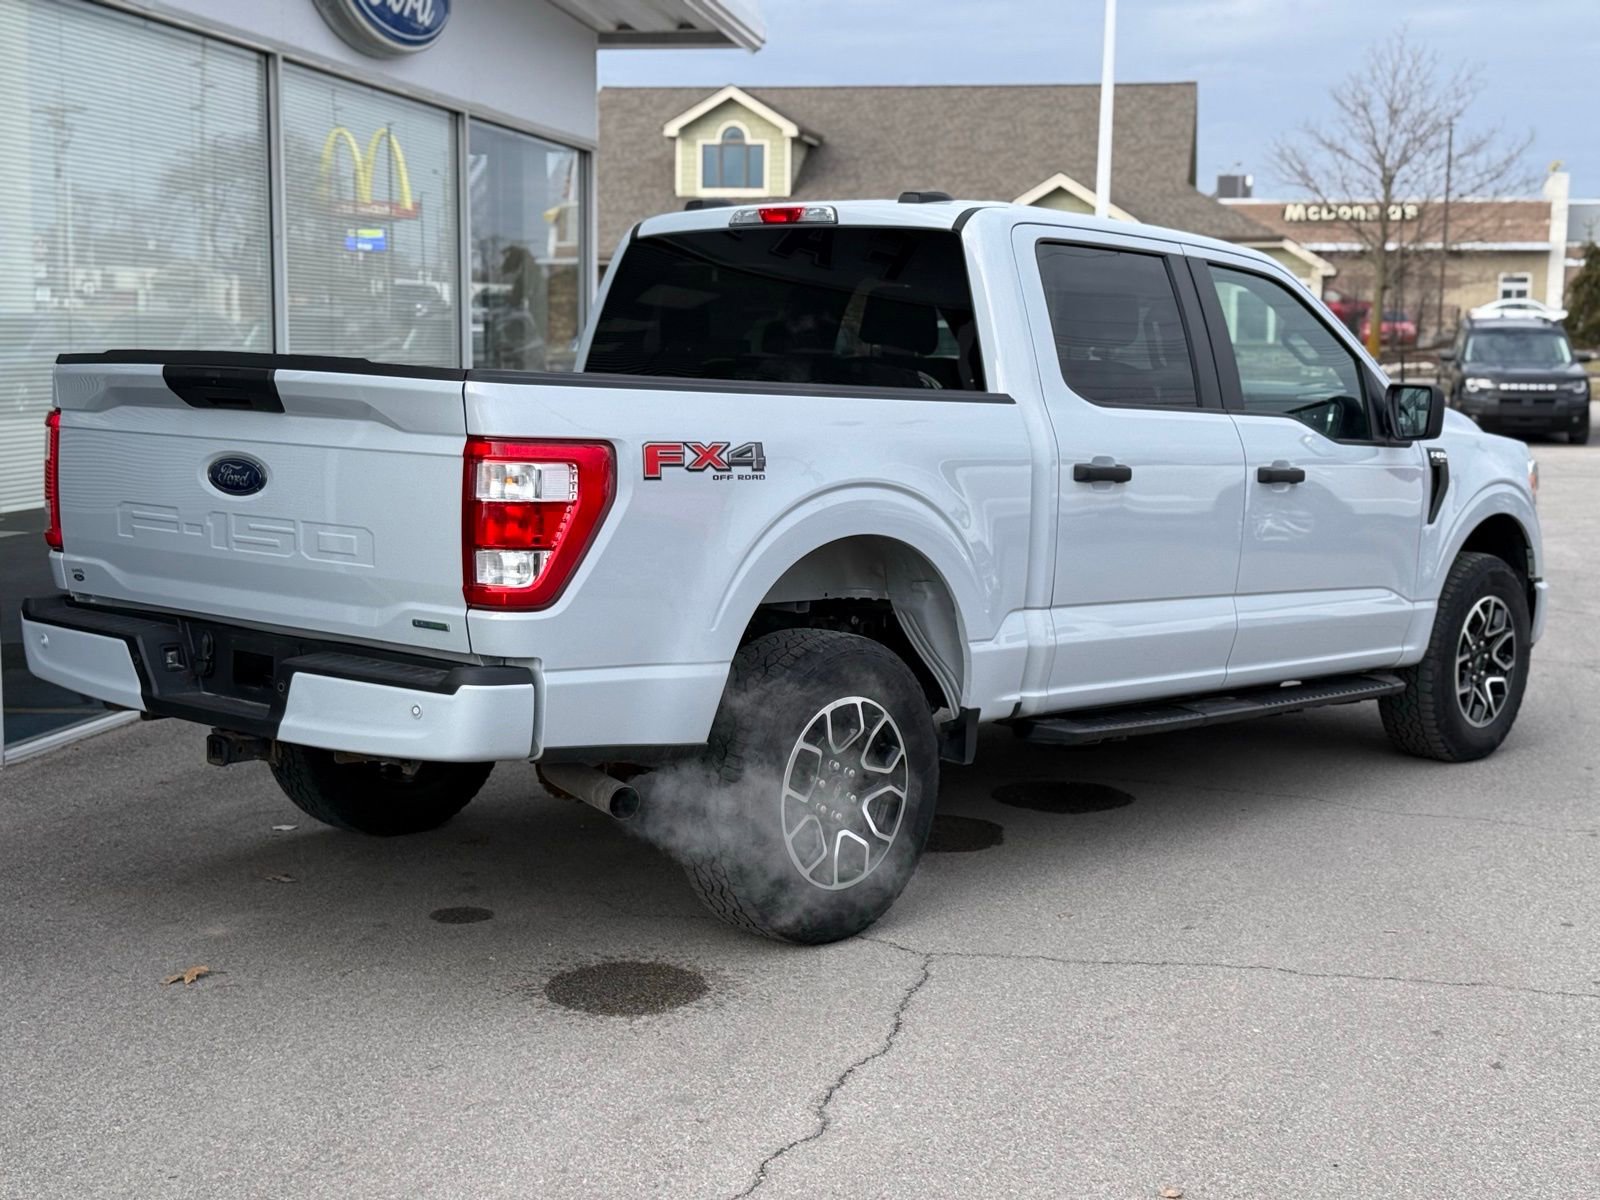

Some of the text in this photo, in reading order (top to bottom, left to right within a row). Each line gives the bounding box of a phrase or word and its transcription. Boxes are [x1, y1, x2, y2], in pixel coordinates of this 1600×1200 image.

[217, 463, 250, 487] Ford
[642, 441, 766, 480] FX4
[117, 501, 375, 568] F-150
